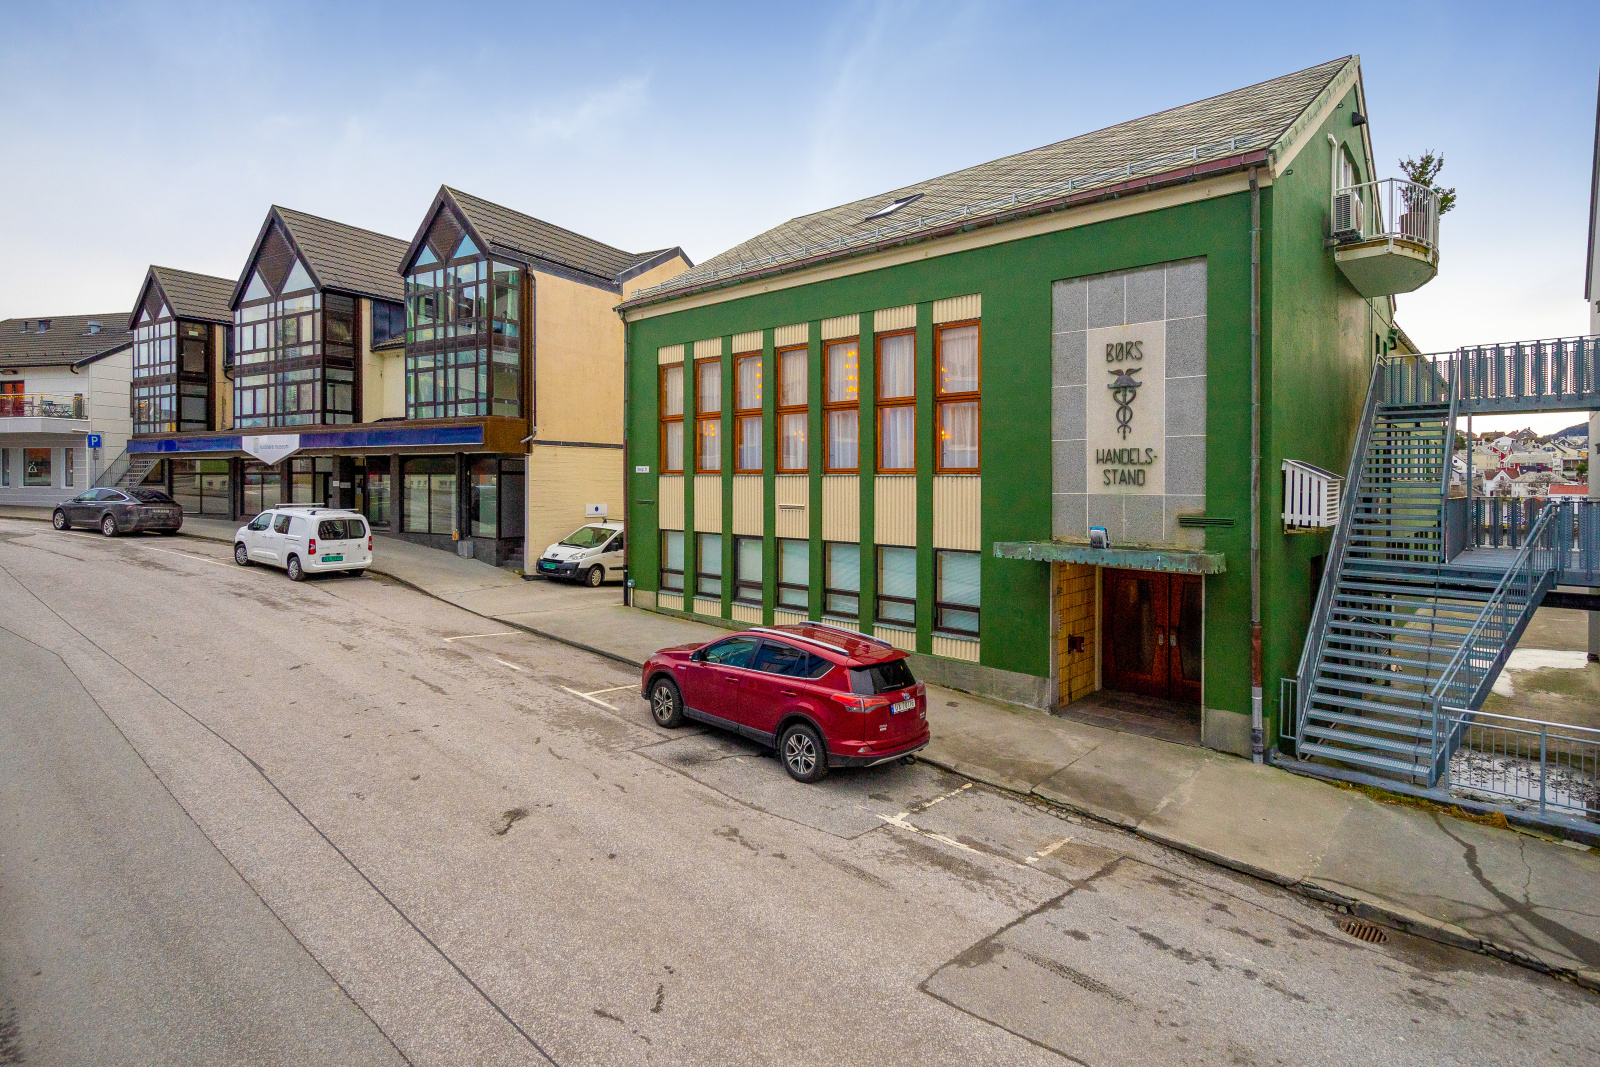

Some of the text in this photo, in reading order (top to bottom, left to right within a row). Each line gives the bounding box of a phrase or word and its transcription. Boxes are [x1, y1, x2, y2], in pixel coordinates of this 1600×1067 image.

[1106, 340, 1144, 363] BØRS
[1096, 447, 1158, 465] HANDELS-
[1103, 468, 1146, 487] STAND
